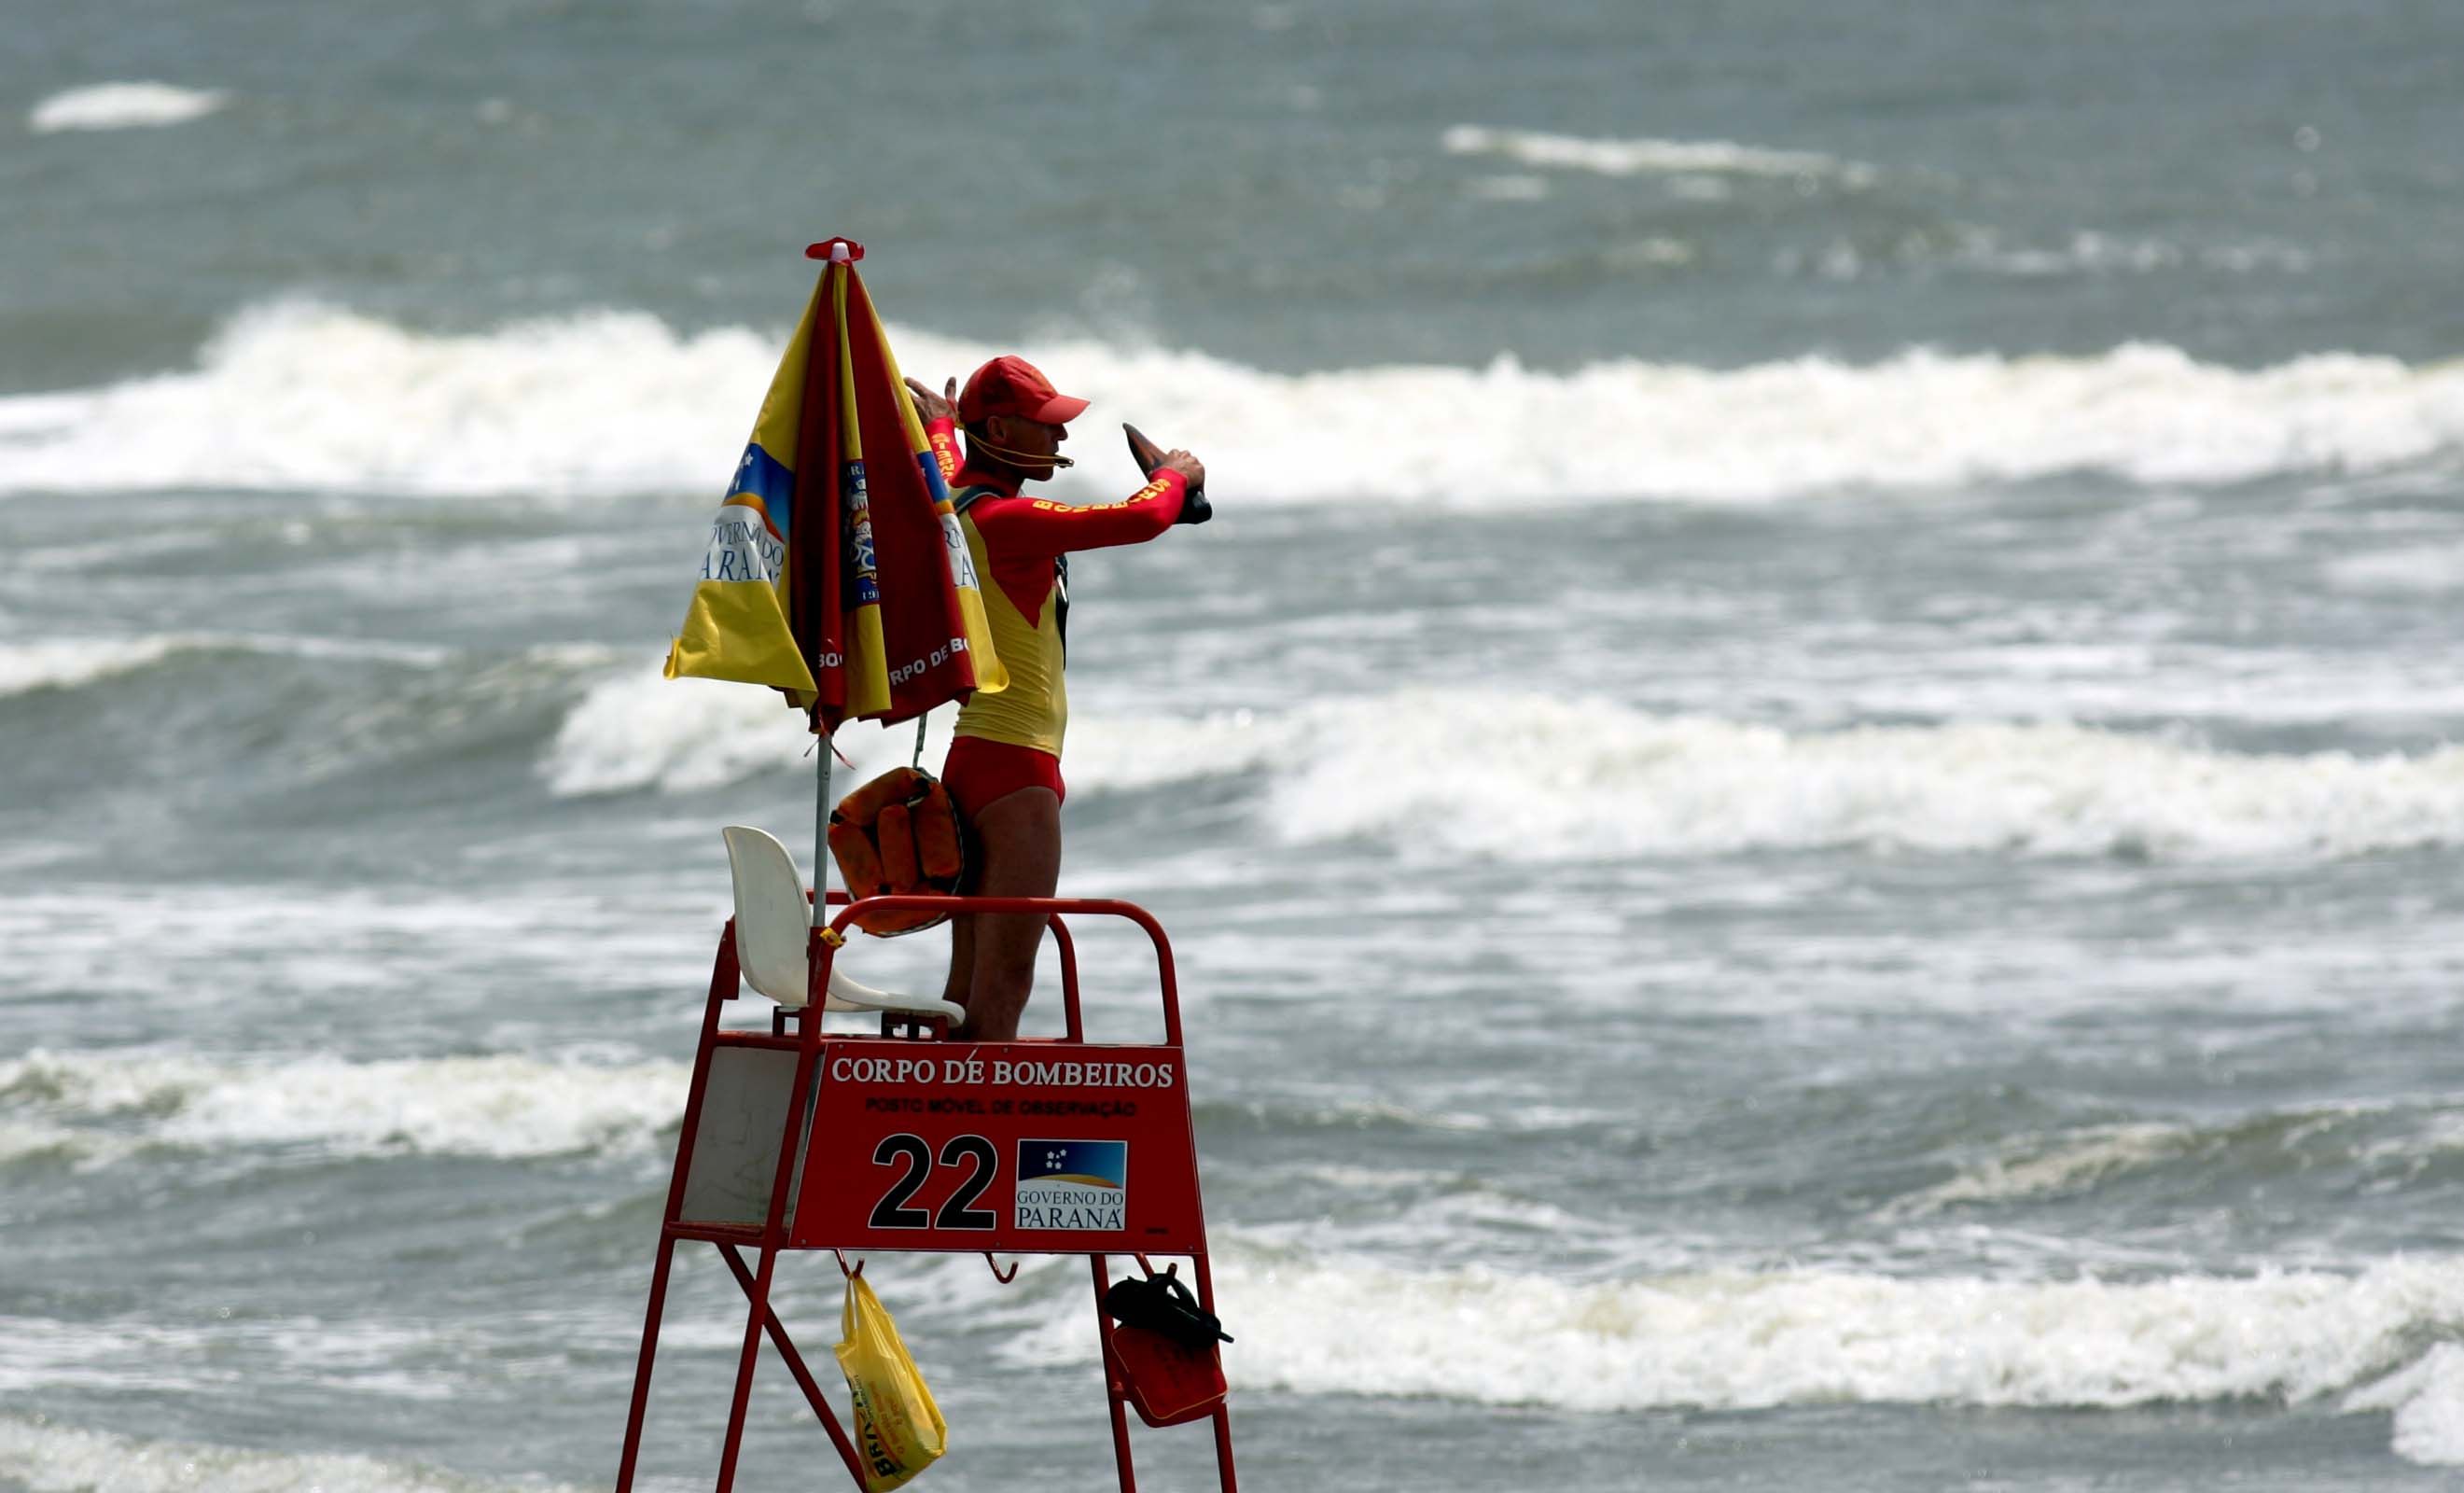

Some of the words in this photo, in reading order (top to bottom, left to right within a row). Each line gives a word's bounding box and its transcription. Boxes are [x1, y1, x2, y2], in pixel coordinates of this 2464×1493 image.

[929, 644, 948, 667] DE
[831, 1057, 936, 1083] CORPO
[992, 1060, 1173, 1088] BOMBEIROS
[992, 1099, 1015, 1115] DE
[868, 1133, 998, 1231] 22
[1017, 1190, 1096, 1206] GOVERNO
[1100, 1192, 1123, 1206] DO
[1017, 1207, 1122, 1229] PARANÁ
